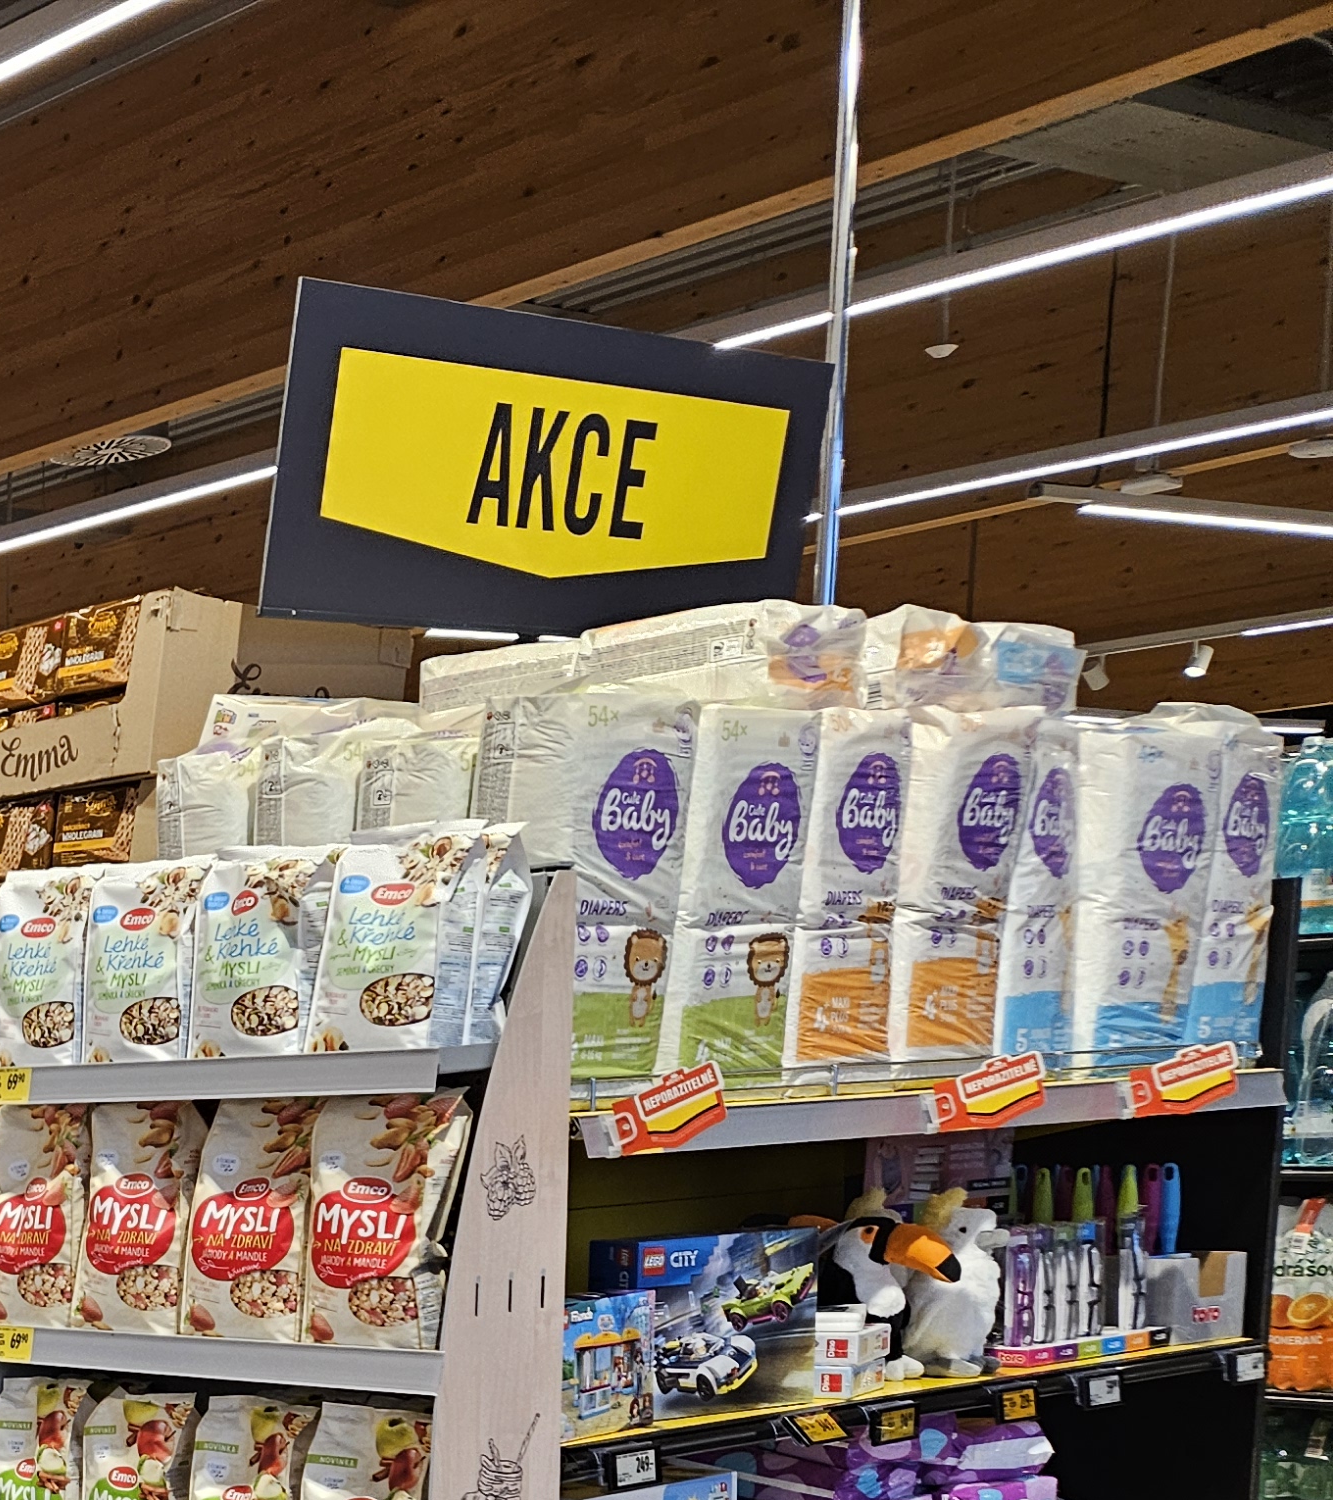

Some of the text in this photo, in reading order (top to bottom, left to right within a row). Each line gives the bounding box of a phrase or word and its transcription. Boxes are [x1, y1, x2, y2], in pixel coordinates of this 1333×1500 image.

[466, 402, 659, 540] AKCE
[1, 735, 78, 782] Emma
[601, 788, 671, 850] Baby
[729, 800, 793, 861] Baby
[842, 788, 897, 847] Baby
[375, 887, 412, 900] Emco
[580, 900, 629, 916] DIAPERS
[123, 912, 154, 926] Emco
[110, 973, 147, 986] MYSLI
[643, 1067, 715, 1111] NEPORAZITELNÉ
[348, 1182, 388, 1196] Emco
[201, 1200, 281, 1239] MYSLI
[316, 1202, 407, 1244] MYSLI
[324, 1239, 400, 1256] NA ZDRAVÍ
[643, 1249, 698, 1268] LEGO CITY
